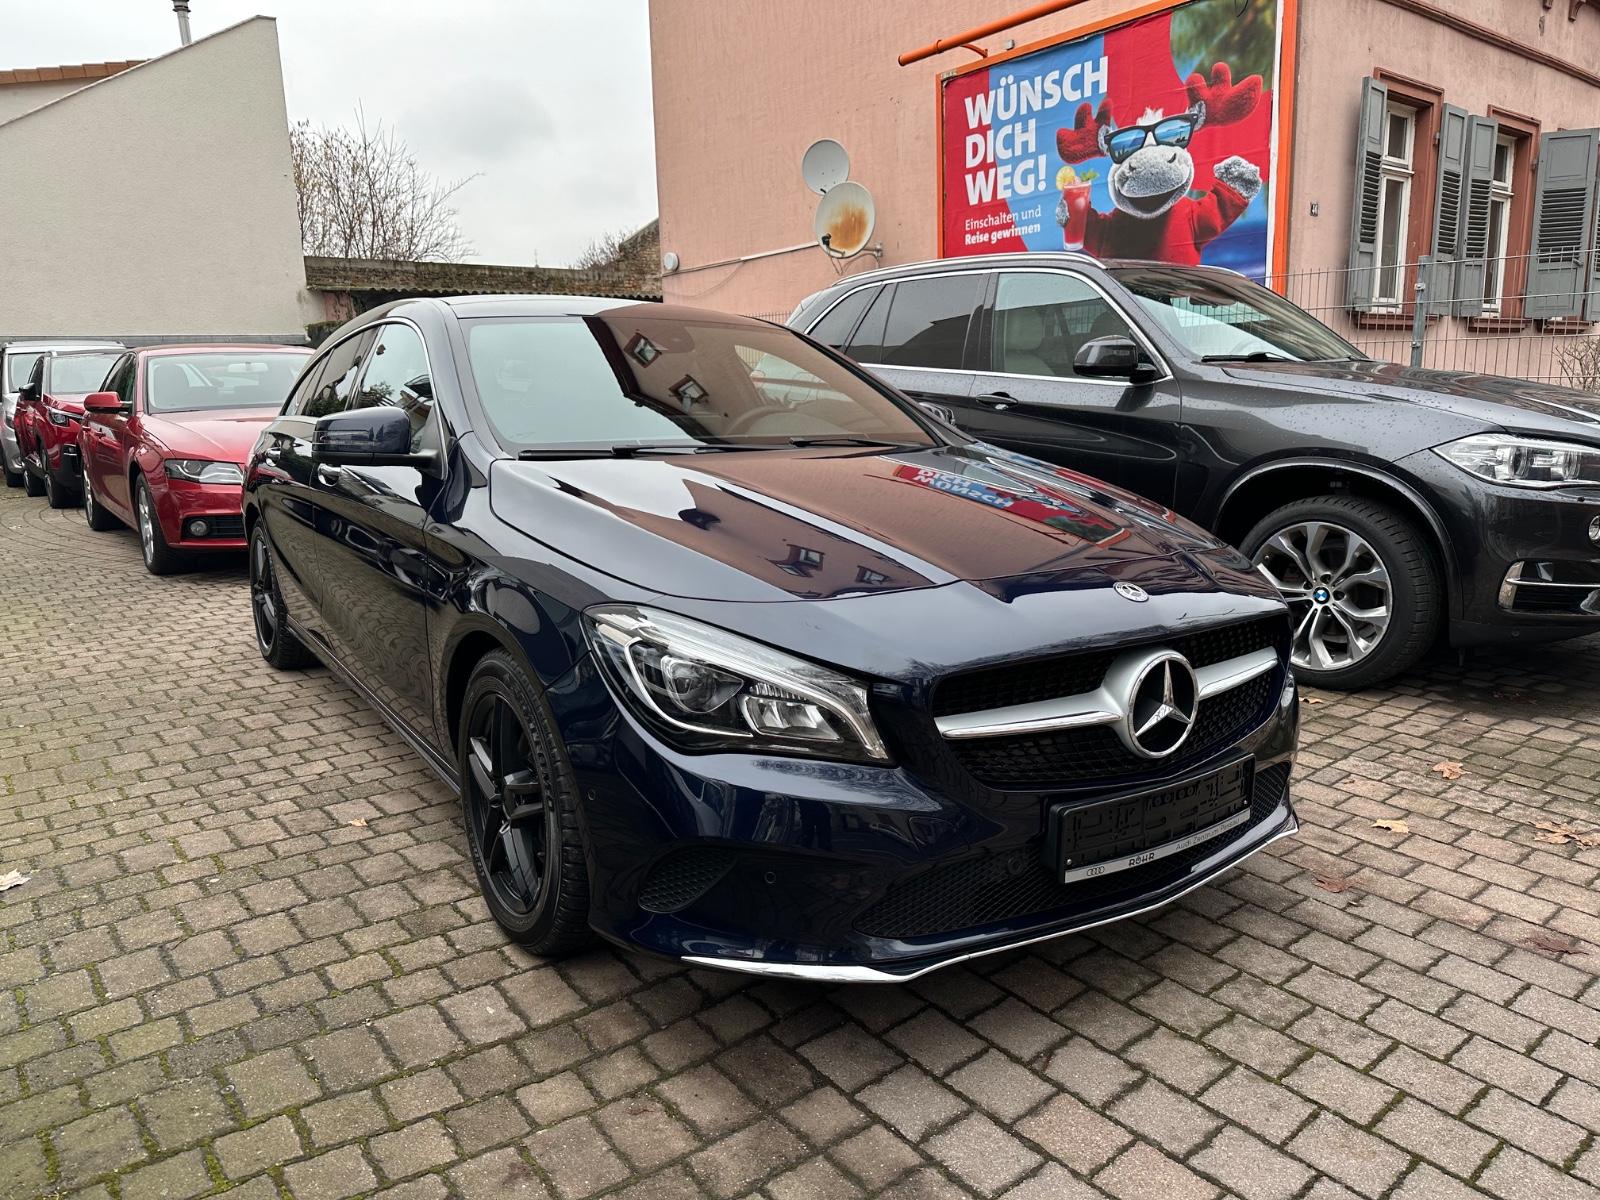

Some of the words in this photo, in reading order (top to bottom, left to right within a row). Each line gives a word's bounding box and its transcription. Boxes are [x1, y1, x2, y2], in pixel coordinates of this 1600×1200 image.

[964, 56, 1109, 130] WÜNSCH
[965, 118, 1036, 169] DICH
[964, 154, 1047, 206] WEG!
[965, 212, 1019, 231] Einschalten
[1021, 204, 1041, 220] und
[965, 231, 989, 246] Reise
[990, 223, 1041, 244] gewinnen
